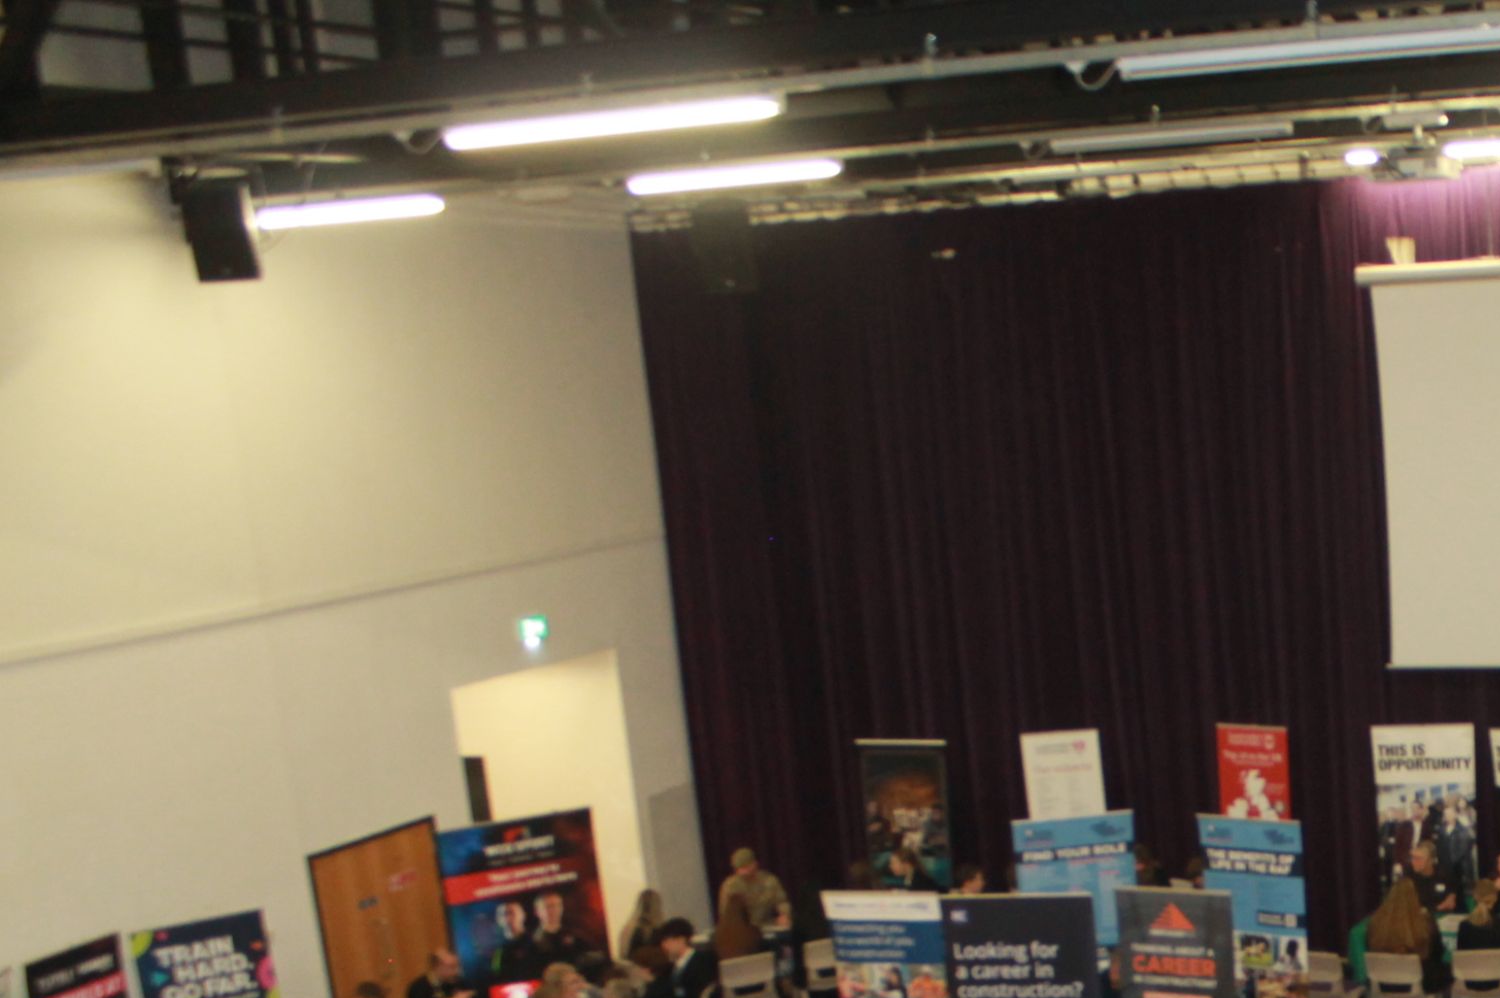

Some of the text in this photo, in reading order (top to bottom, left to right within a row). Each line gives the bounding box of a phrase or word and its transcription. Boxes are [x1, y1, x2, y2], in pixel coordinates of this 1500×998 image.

[1378, 743, 1425, 756] THIS IS
[1378, 757, 1472, 771] OPPORTUNITY
[1022, 842, 1127, 863] FIND YOUR ROLE
[154, 935, 234, 968] TRAIN
[953, 940, 1058, 962] Looking for
[173, 953, 255, 984] HARD.
[955, 962, 1055, 979] a career in
[1132, 954, 1217, 977] CAREER
[204, 972, 258, 997] FAR.
[957, 982, 1085, 998] construction?
